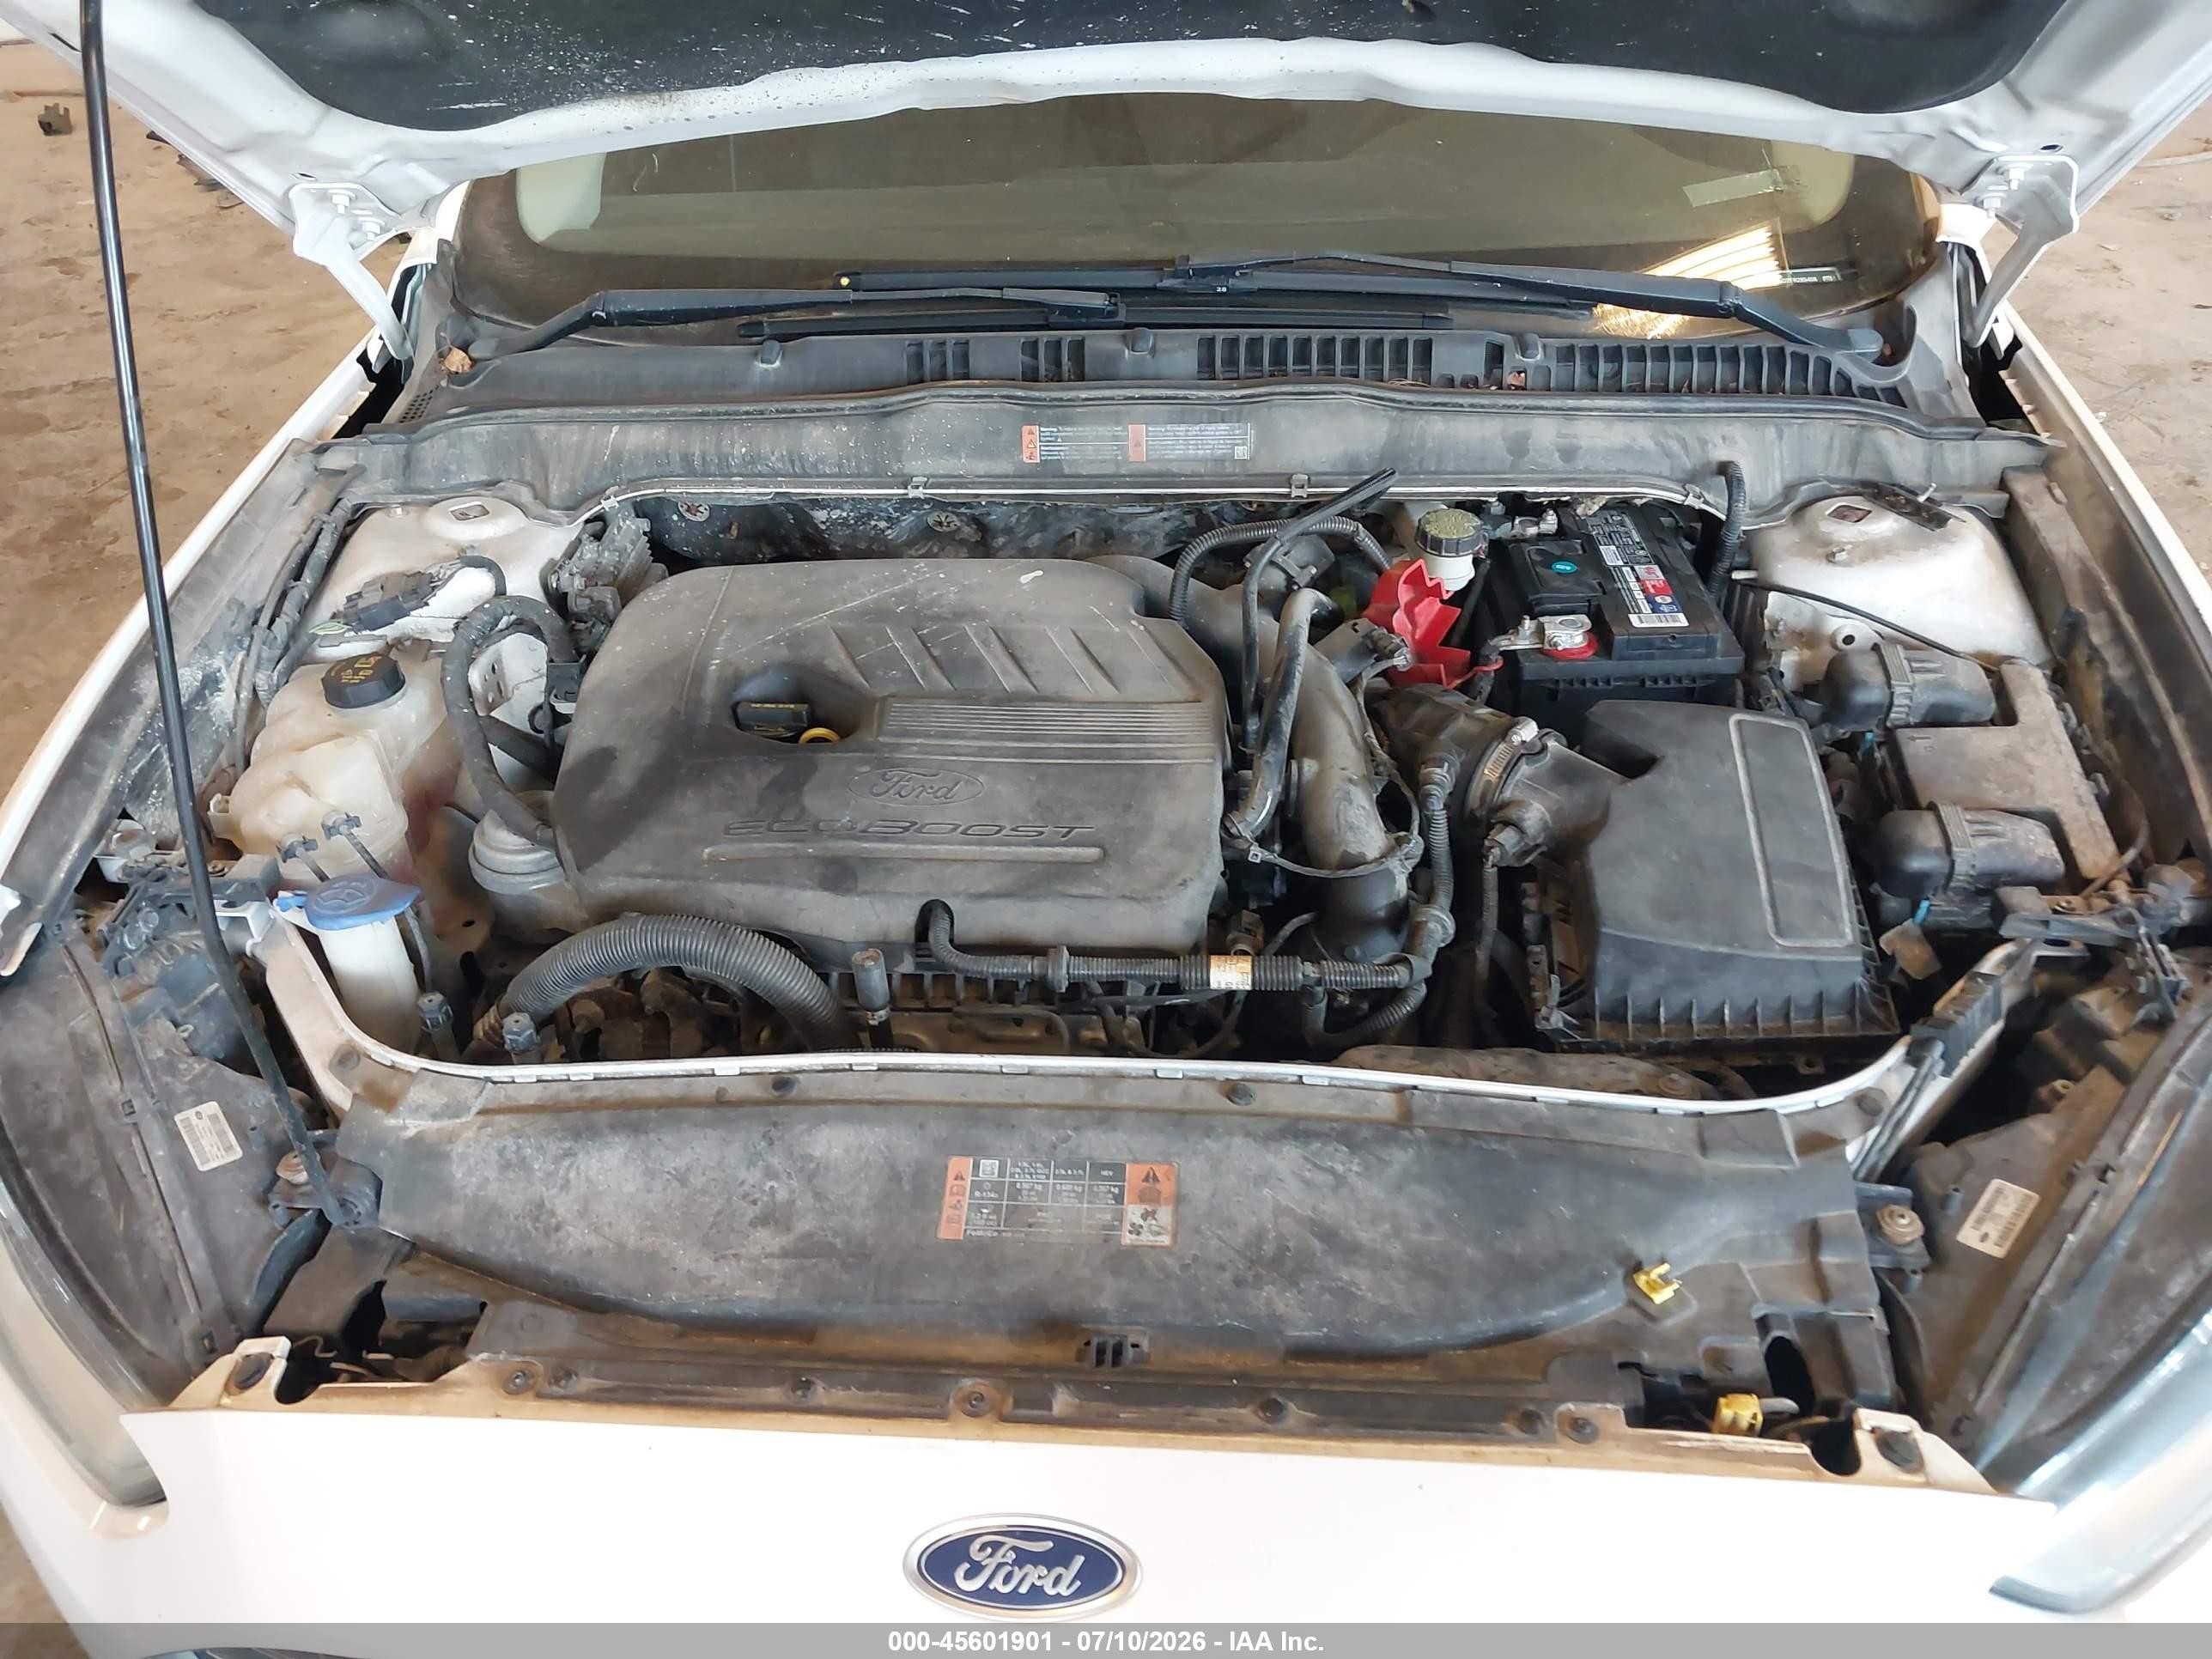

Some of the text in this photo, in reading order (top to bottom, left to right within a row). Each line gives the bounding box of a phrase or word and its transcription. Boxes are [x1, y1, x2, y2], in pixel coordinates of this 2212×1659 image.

[869, 769, 963, 801] Ford
[724, 817, 1097, 840] ECOBOOST
[954, 1534, 1085, 1597] Ford
